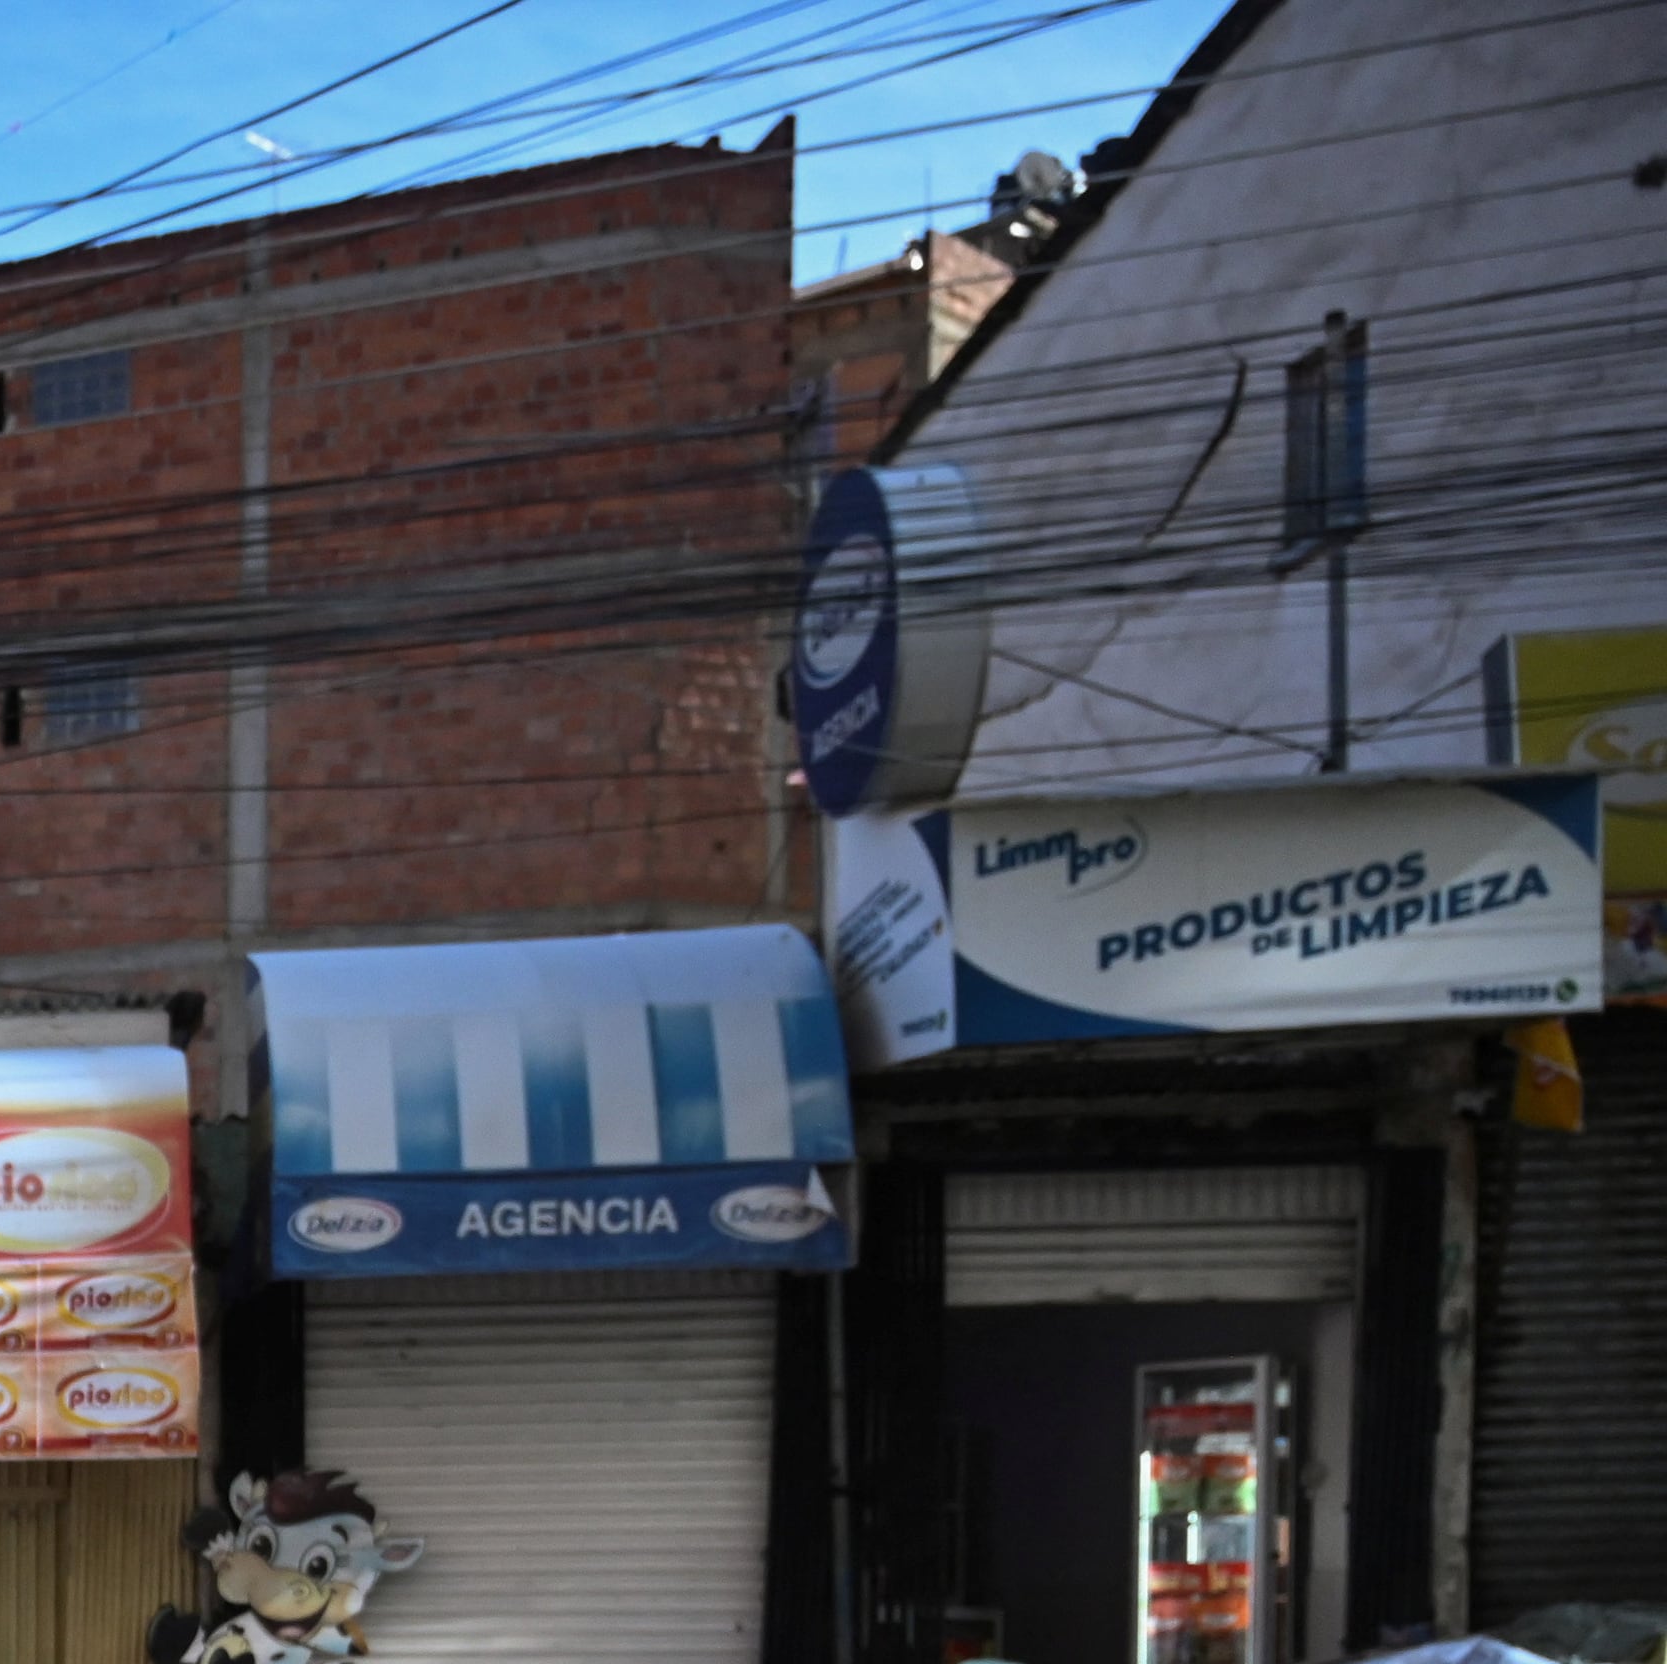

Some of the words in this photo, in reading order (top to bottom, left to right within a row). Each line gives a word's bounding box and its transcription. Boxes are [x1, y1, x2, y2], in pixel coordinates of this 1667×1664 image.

[1097, 850, 1426, 972] PRODUCTOS
[1252, 930, 1292, 955] DE
[1300, 864, 1549, 959] LIMPIEZA
[457, 1198, 679, 1238] AGENCIA
